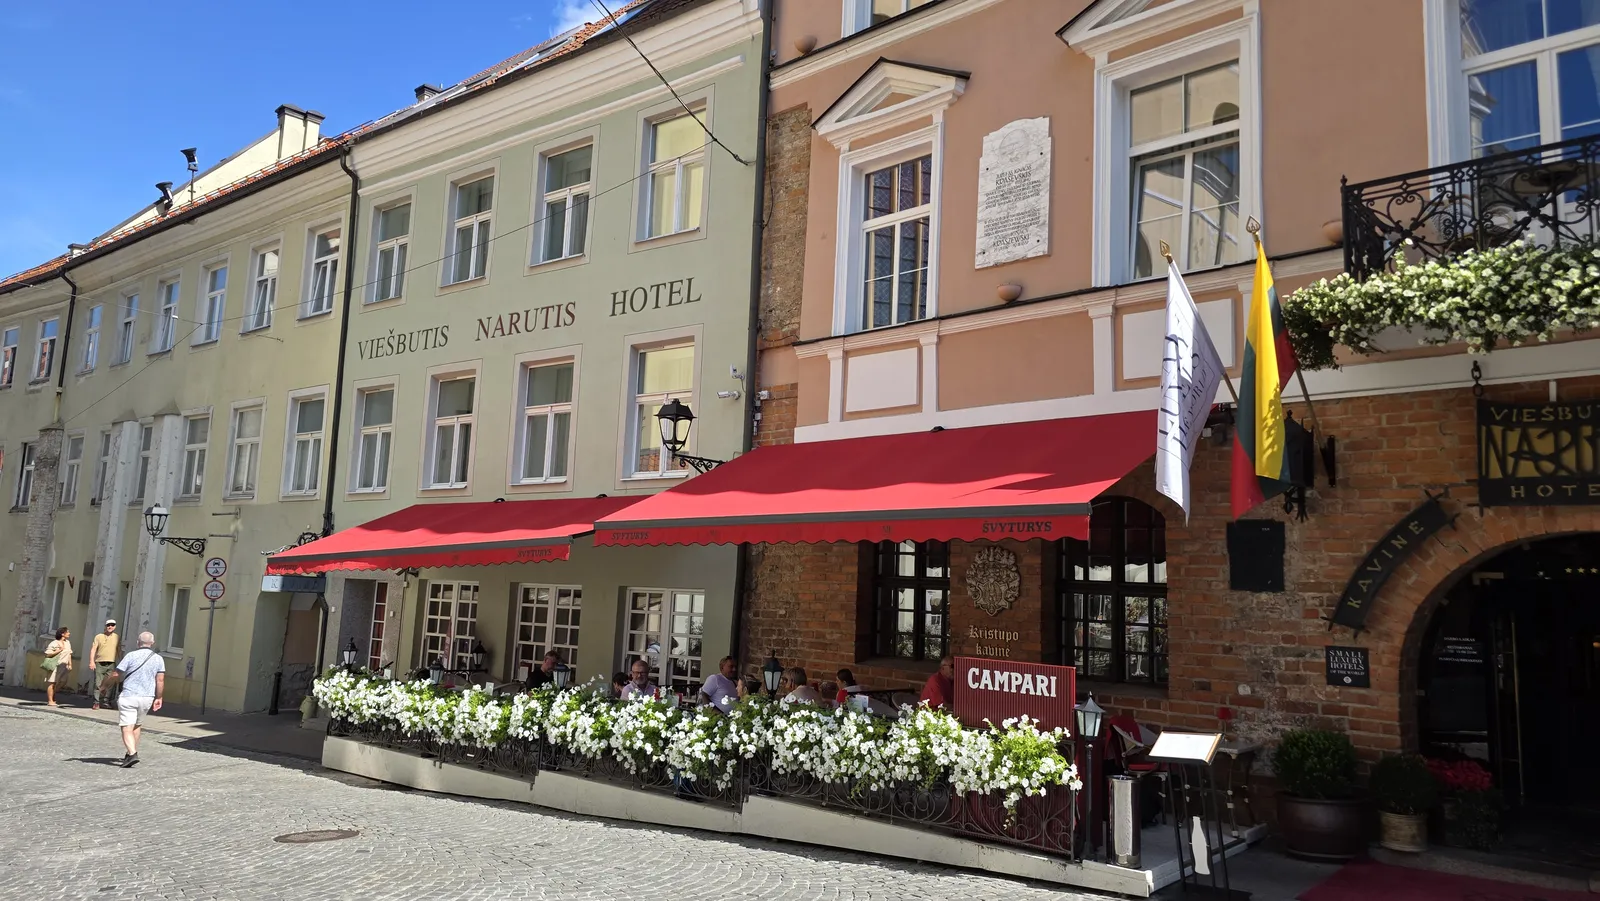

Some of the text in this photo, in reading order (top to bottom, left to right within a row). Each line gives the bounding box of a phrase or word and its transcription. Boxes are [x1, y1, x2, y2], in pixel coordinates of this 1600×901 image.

[358, 277, 702, 360] VIEŠBUTIS NARUTIS HOTEL
[982, 520, 1051, 533] ŠVYTURYS
[969, 625, 1019, 642] Kristupo
[976, 642, 1010, 657] kavinė
[1329, 650, 1364, 658] SMALL
[1330, 656, 1364, 666] LUXURY
[1330, 663, 1364, 671] HOTELS
[968, 667, 1057, 698] CAMPARI
